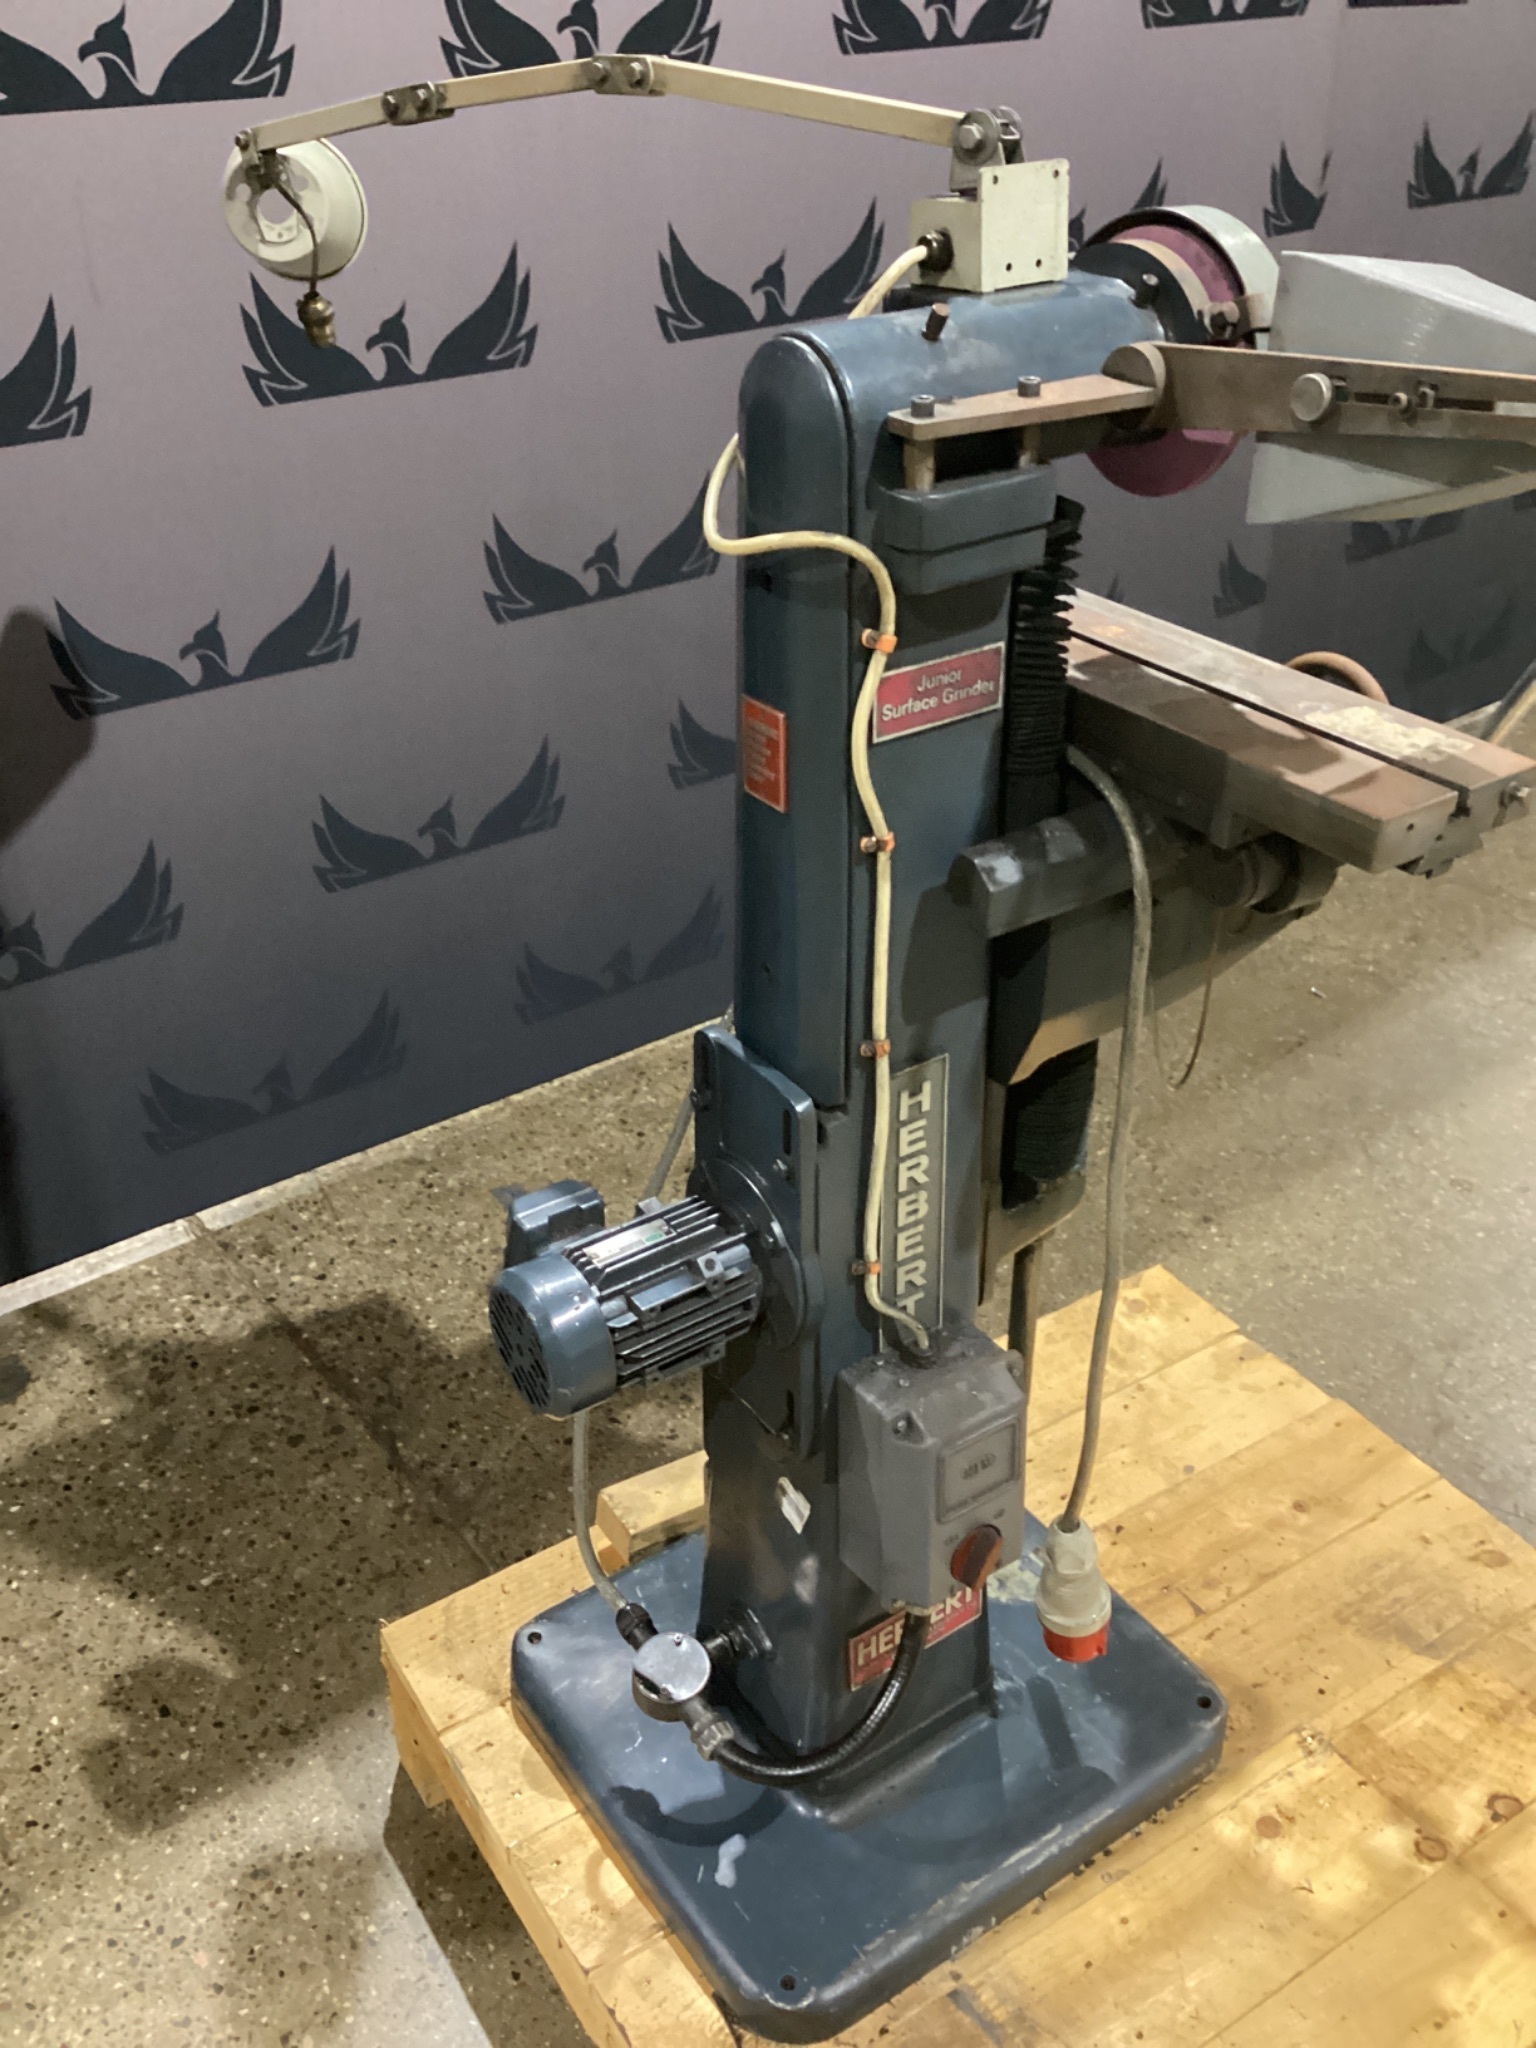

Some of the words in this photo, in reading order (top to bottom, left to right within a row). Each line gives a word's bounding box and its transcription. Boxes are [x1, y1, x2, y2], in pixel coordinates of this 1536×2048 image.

[881, 697, 938, 721] Surface
[942, 679, 995, 704] Grinder
[917, 670, 962, 692] Junior
[896, 1079, 932, 1317] HERBERT
[856, 1586, 973, 1667] HEER
